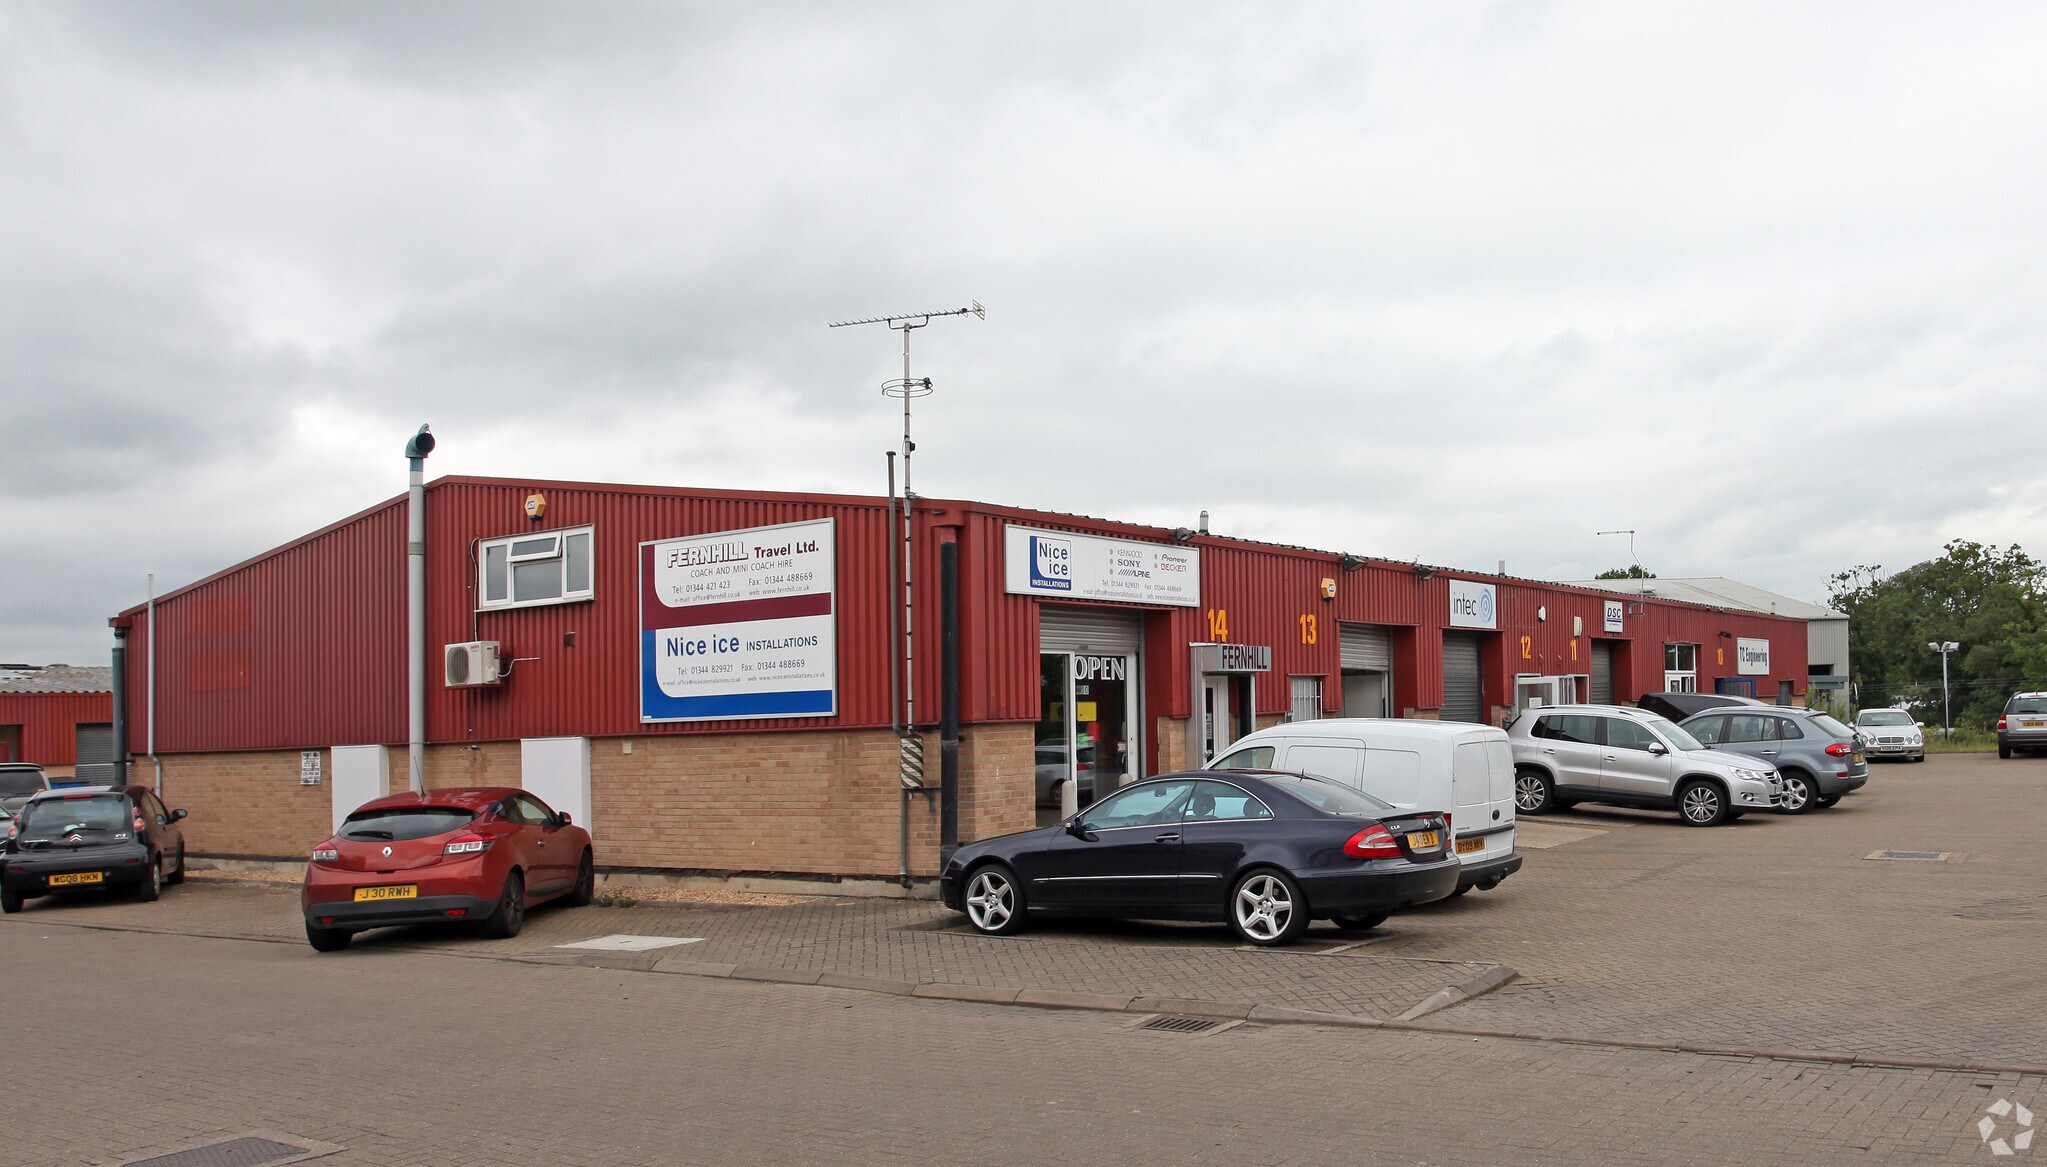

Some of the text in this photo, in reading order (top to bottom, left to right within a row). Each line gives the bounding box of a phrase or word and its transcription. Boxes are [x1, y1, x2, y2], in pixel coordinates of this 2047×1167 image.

[667, 540, 819, 568] FERNHILL Travel Ltd.
[1039, 542, 1068, 560] Nice
[1117, 550, 1143, 559] KENWOOD
[1161, 554, 1188, 564] Pioneer
[691, 559, 793, 578] COACH AND MINI COACH HIRE
[1049, 562, 1068, 576] ice
[1117, 559, 1141, 568] SONY
[1160, 564, 1187, 573] BECKER
[673, 580, 730, 594] Tel: 01344 421 423
[749, 572, 813, 586] Fax: 01344 488669
[1032, 579, 1069, 589] INSTALLATIONS
[1453, 592, 1477, 616] intec
[1607, 607, 1621, 618] DSC
[1208, 608, 1228, 642] 14
[1300, 614, 1317, 645] 13
[667, 634, 818, 657] Nice ice INSTALLATIONS
[1520, 635, 1532, 659] 12
[1570, 639, 1577, 661] 11
[1222, 646, 1267, 669] FERNHILL
[1746, 646, 1767, 666] Engineering
[677, 659, 806, 676] Tel: 01344 829921 Fax: 01344 488669
[1074, 656, 1125, 680] OPEN
[80, 873, 99, 882] HKN
[362, 887, 411, 899] J 30 RWH
